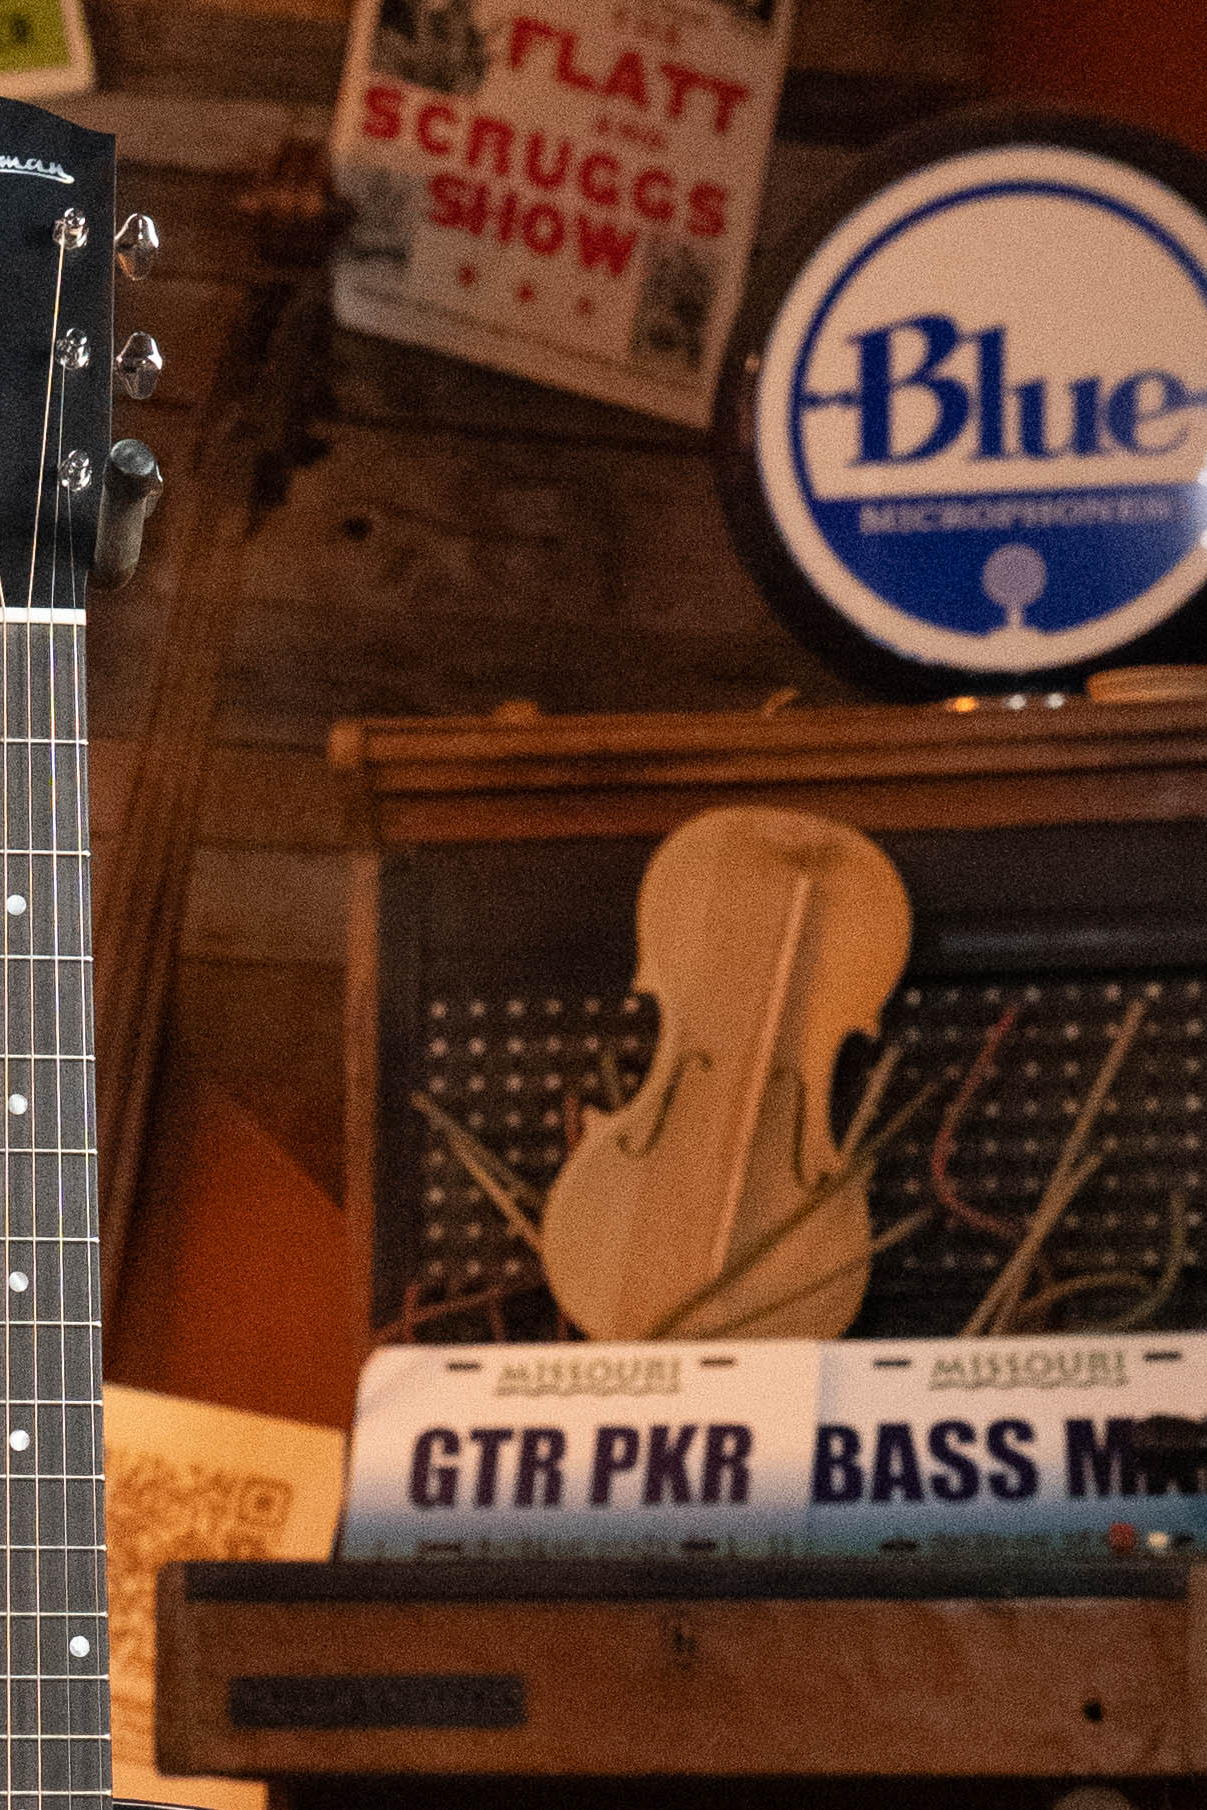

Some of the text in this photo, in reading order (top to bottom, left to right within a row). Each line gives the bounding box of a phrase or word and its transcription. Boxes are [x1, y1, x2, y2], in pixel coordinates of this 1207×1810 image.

[506, 16, 752, 134] FLATT
[362, 84, 727, 238] SCRUGGS
[427, 172, 639, 278] SHOW
[846, 313, 1189, 468] Blue
[495, 1356, 683, 1395] MISSOURI
[929, 1349, 1129, 1391] MISSOURI
[408, 1424, 755, 1508] GTR PKR
[811, 1418, 1037, 1504] BASS
